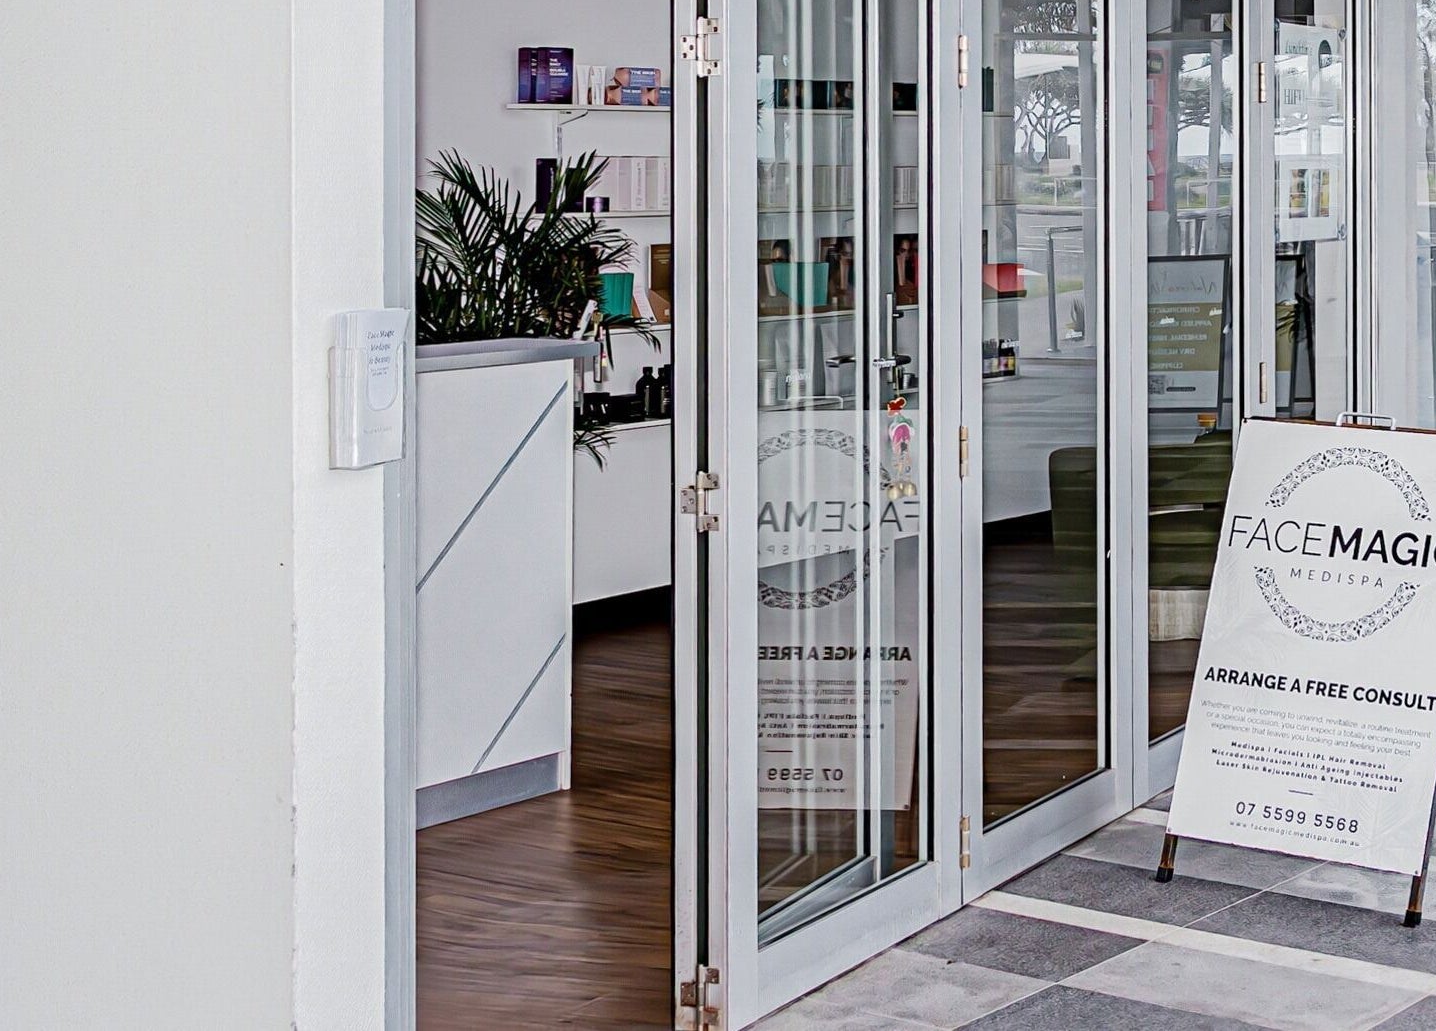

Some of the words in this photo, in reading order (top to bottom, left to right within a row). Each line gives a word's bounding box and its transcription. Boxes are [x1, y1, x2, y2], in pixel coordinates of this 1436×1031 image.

[1289, 568, 1385, 589] MEDISPA
[1204, 665, 1287, 691] ARRANGE
[1289, 677, 1301, 693] A
[1305, 679, 1348, 700] FREE
[1259, 707, 1285, 719] coming
[1394, 726, 1430, 739] treatment
[1281, 721, 1294, 731] you
[1231, 740, 1264, 754] Medispa
[1273, 746, 1303, 758] Facials
[1312, 752, 1325, 761] IPL
[1328, 754, 1346, 764] Hair
[1349, 757, 1385, 770] Removal
[1252, 726, 1264, 735] that
[1291, 733, 1304, 742] you
[1306, 734, 1332, 746] looking
[1334, 738, 1348, 747] and
[1349, 740, 1374, 752] feeling
[1376, 745, 1392, 755] your
[1211, 747, 1291, 766] Microdermabrasion
[1300, 761, 1317, 770] Anti
[1320, 764, 1349, 776] Ageing
[1353, 769, 1402, 784] Injectables
[1216, 758, 1239, 769] Laser
[1241, 762, 1259, 772] Skin
[1262, 765, 1317, 782] Rejuvenation
[1320, 774, 1326, 782] &
[1330, 775, 1357, 787] Tattoo
[1360, 779, 1396, 792] Removal
[1235, 800, 1256, 817] 07
[1262, 804, 1306, 825] 5599
[1313, 812, 1358, 834] 5568
